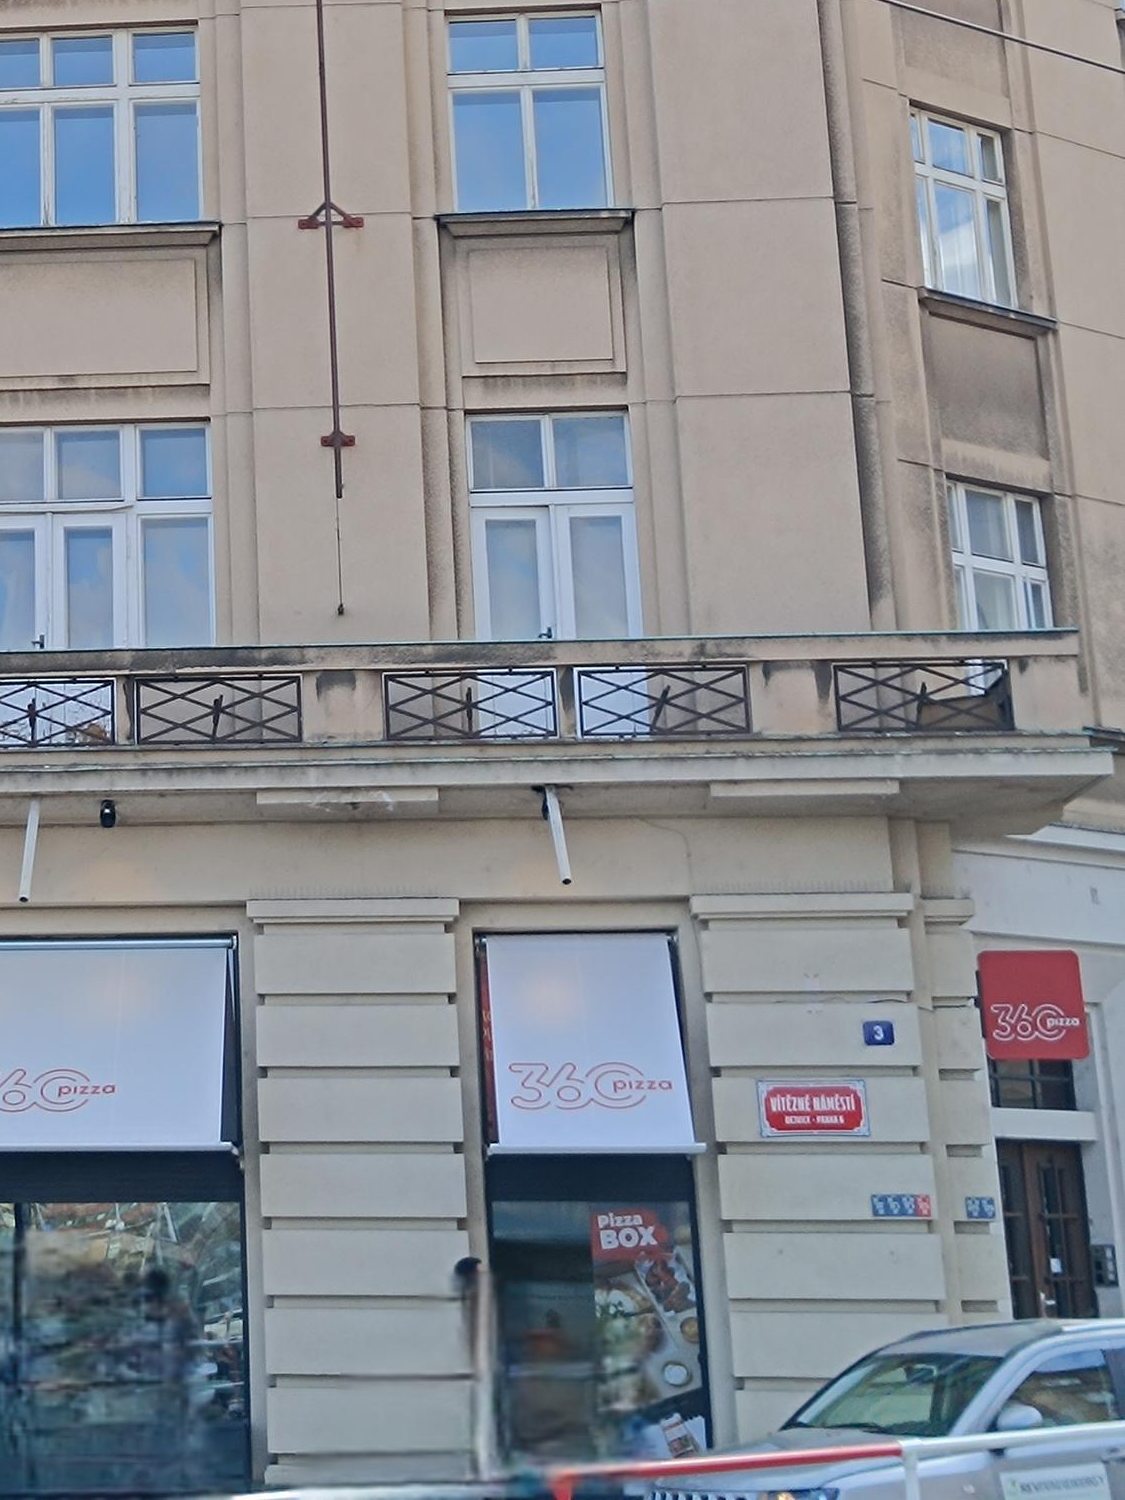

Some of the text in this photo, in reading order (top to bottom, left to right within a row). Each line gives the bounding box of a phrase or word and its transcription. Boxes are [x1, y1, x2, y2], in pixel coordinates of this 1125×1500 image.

[873, 1024, 884, 1041] 3
[990, 1003, 1081, 1041] 360 pizza
[57, 1083, 117, 1098] pizza
[508, 1061, 674, 1110] 360 pizza
[600, 1225, 658, 1250] BOX
